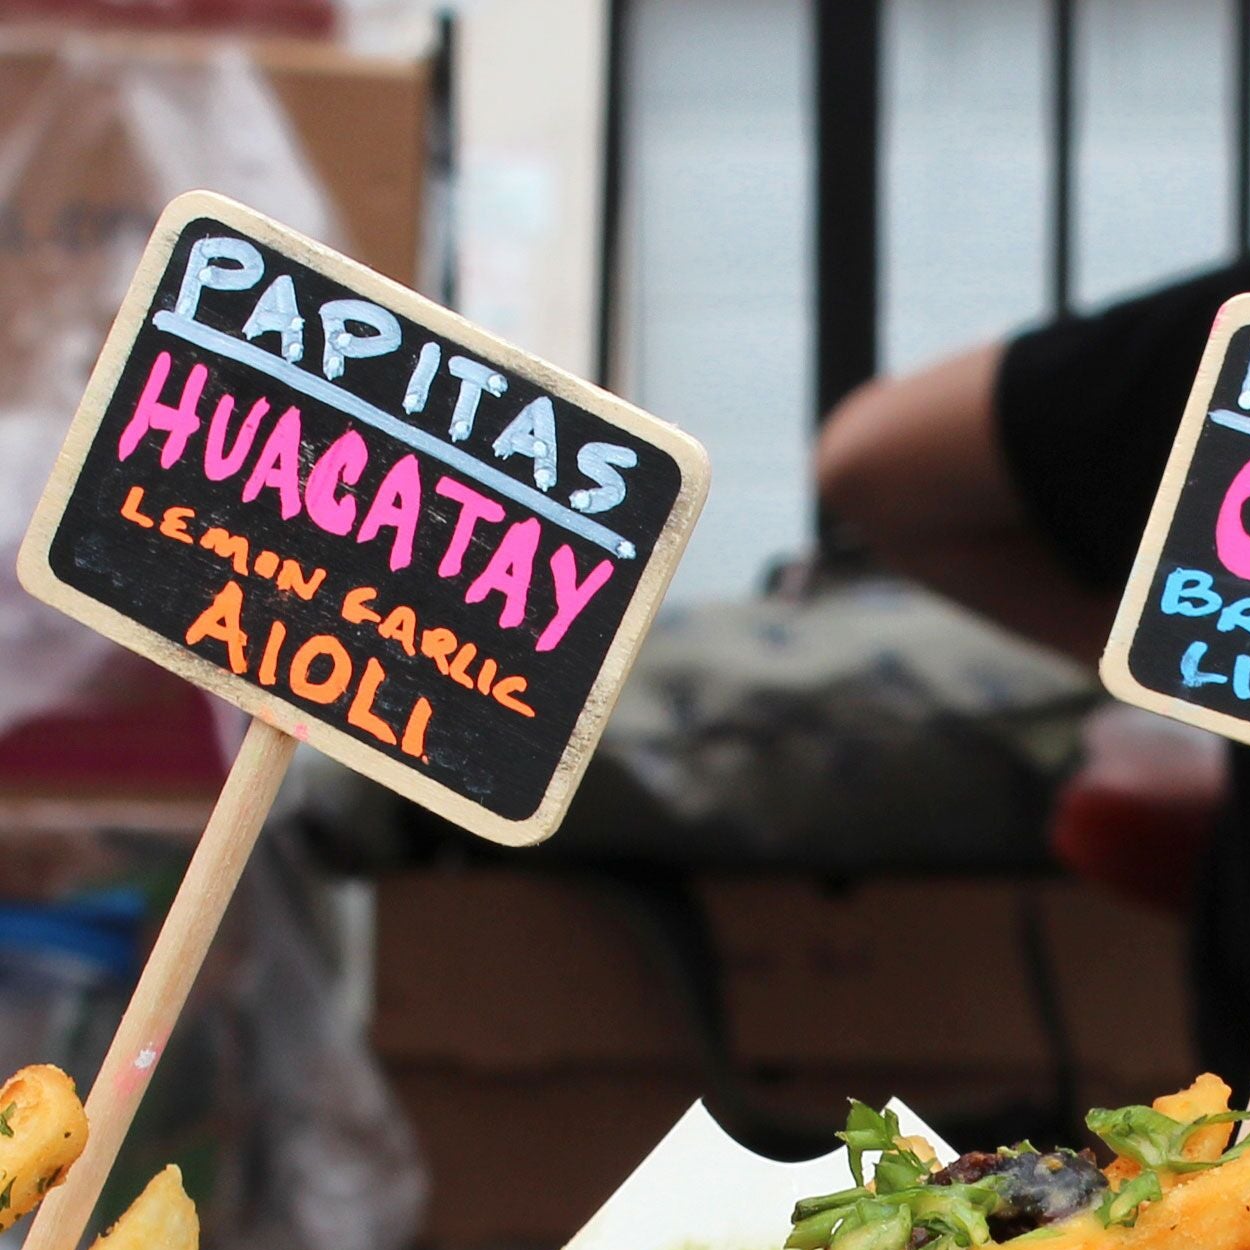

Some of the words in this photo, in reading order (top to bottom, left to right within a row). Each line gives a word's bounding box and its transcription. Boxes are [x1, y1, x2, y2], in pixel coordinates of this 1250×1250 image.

[174, 235, 638, 514] PAPITAS
[118, 350, 616, 653] HUACATAY
[186, 581, 433, 758] AIOLI
[343, 585, 535, 718] GARLIC
